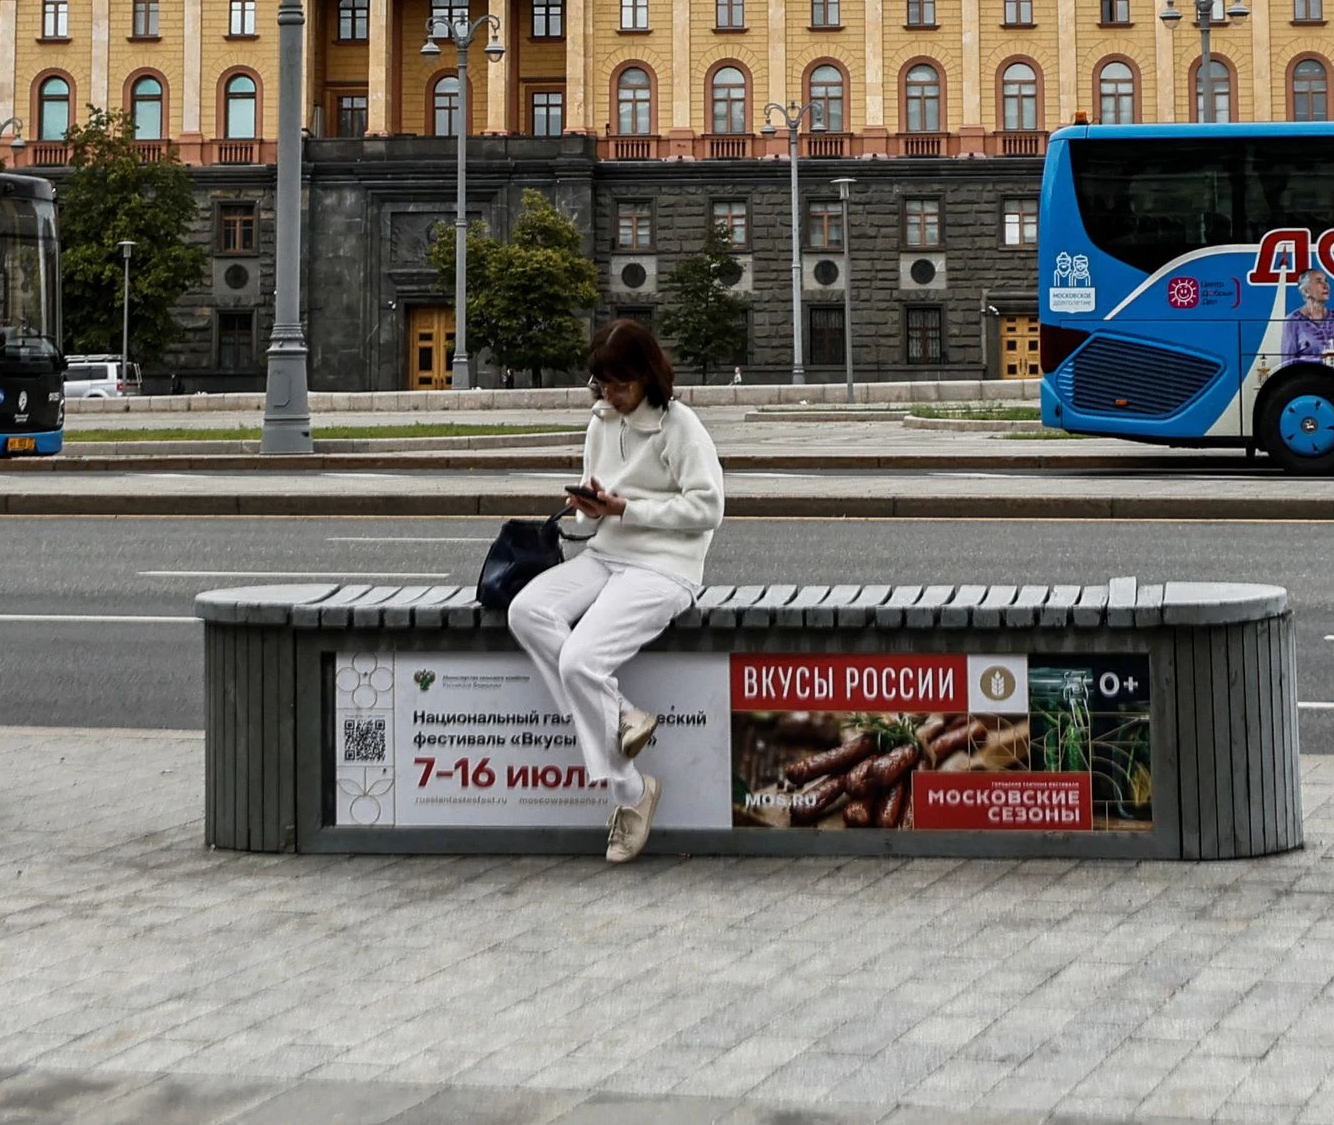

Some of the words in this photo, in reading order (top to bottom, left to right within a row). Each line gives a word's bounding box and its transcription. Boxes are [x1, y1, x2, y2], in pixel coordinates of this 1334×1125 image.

[743, 665, 834, 700] ВКУСЫ
[845, 666, 955, 702] РОССИИ
[1098, 671, 1139, 696] 0+
[413, 710, 539, 727] Национальный
[413, 731, 506, 749] фестиваль
[511, 732, 577, 750] «Вкусы
[744, 793, 817, 808] MOS.RU
[927, 789, 1080, 806] МОСКОВСКИЕ
[987, 806, 1081, 823] СЕЗОНЫ
